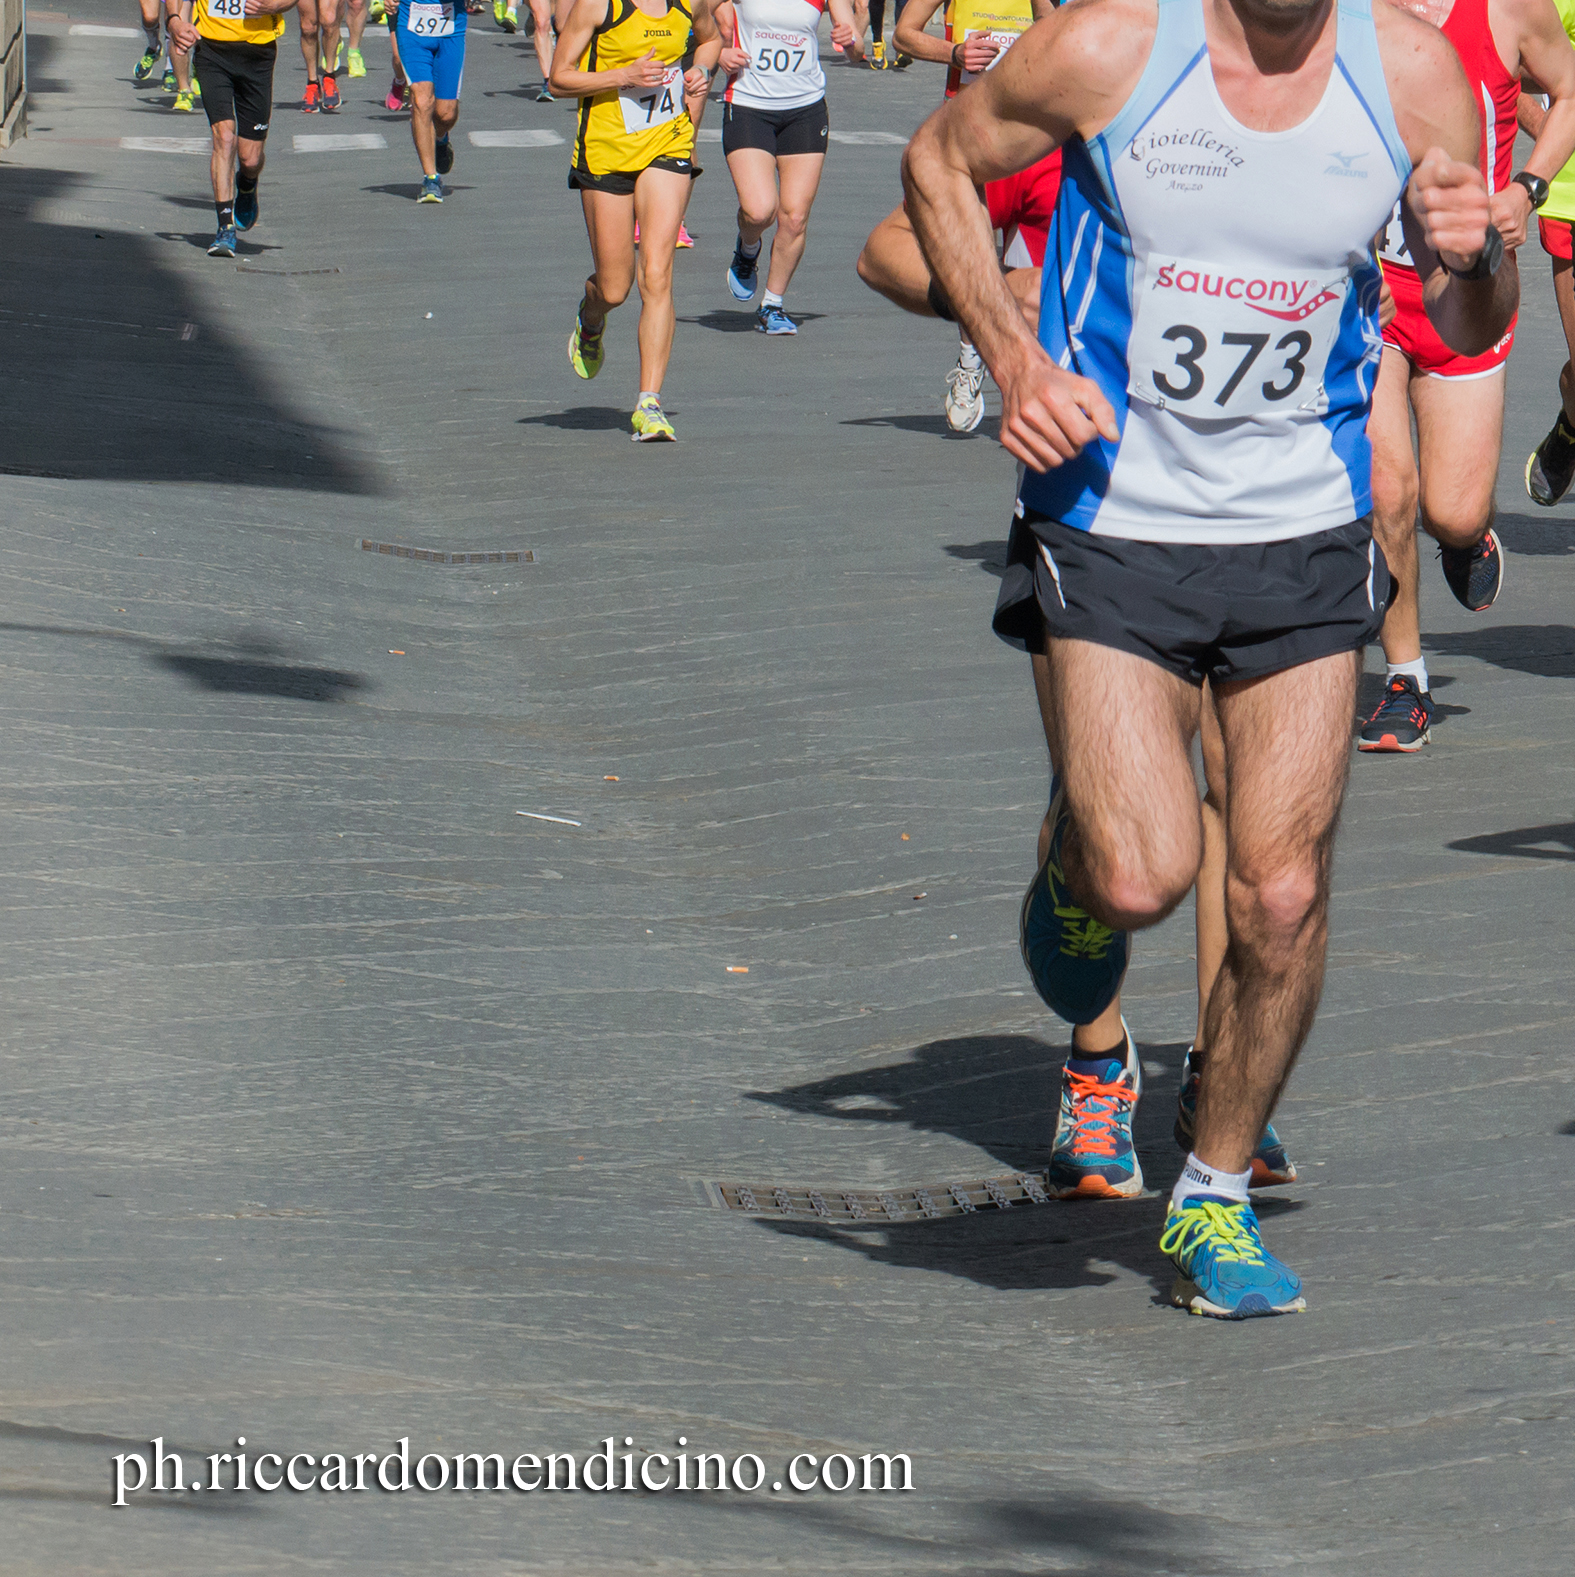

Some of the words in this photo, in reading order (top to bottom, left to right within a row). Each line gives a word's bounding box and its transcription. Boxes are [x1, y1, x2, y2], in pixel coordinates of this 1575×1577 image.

[414, 17, 450, 34] 697
[754, 30, 800, 44] saucony
[756, 48, 806, 73] 507
[639, 91, 674, 124] 74
[1130, 128, 1246, 169] Gioielleria
[1145, 157, 1229, 180] Governini
[1156, 265, 1310, 307] saucony
[1152, 324, 1313, 407] 373
